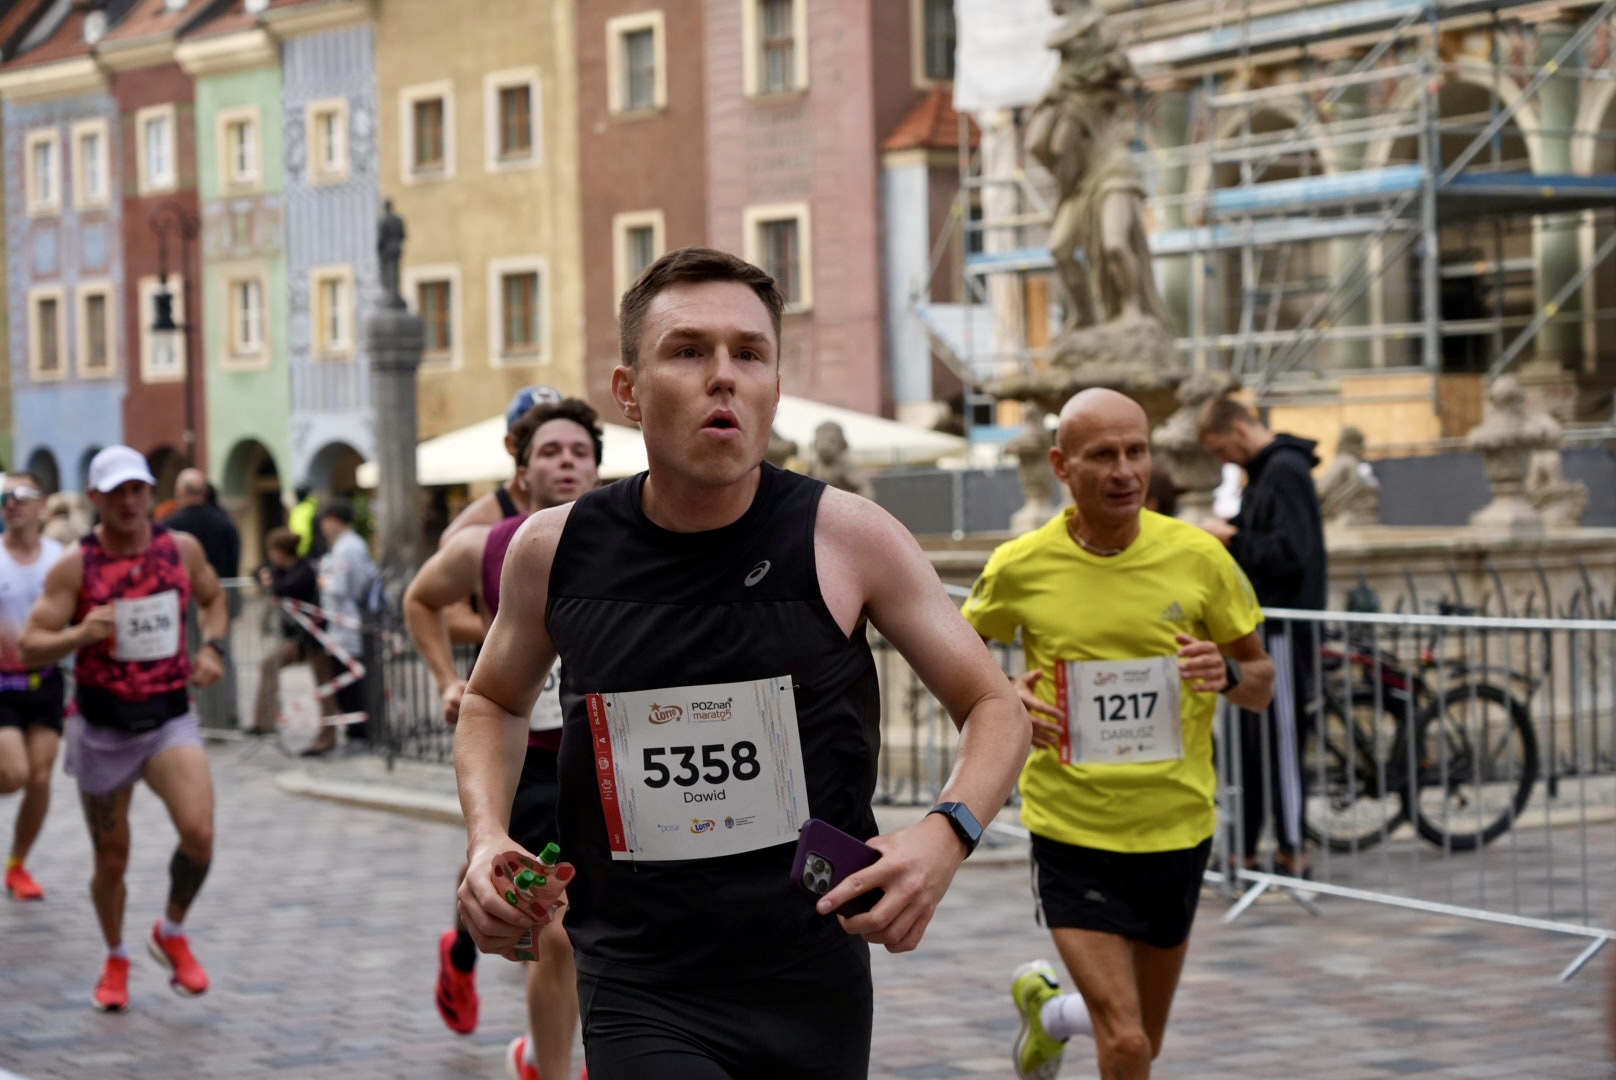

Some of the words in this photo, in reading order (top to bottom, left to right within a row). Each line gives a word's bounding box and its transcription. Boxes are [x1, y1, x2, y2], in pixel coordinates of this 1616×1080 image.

[1093, 691, 1158, 721] 1217
[1101, 726, 1154, 741] DARIUSZ
[643, 741, 760, 788] 5358
[683, 789, 726, 803] Dawid
